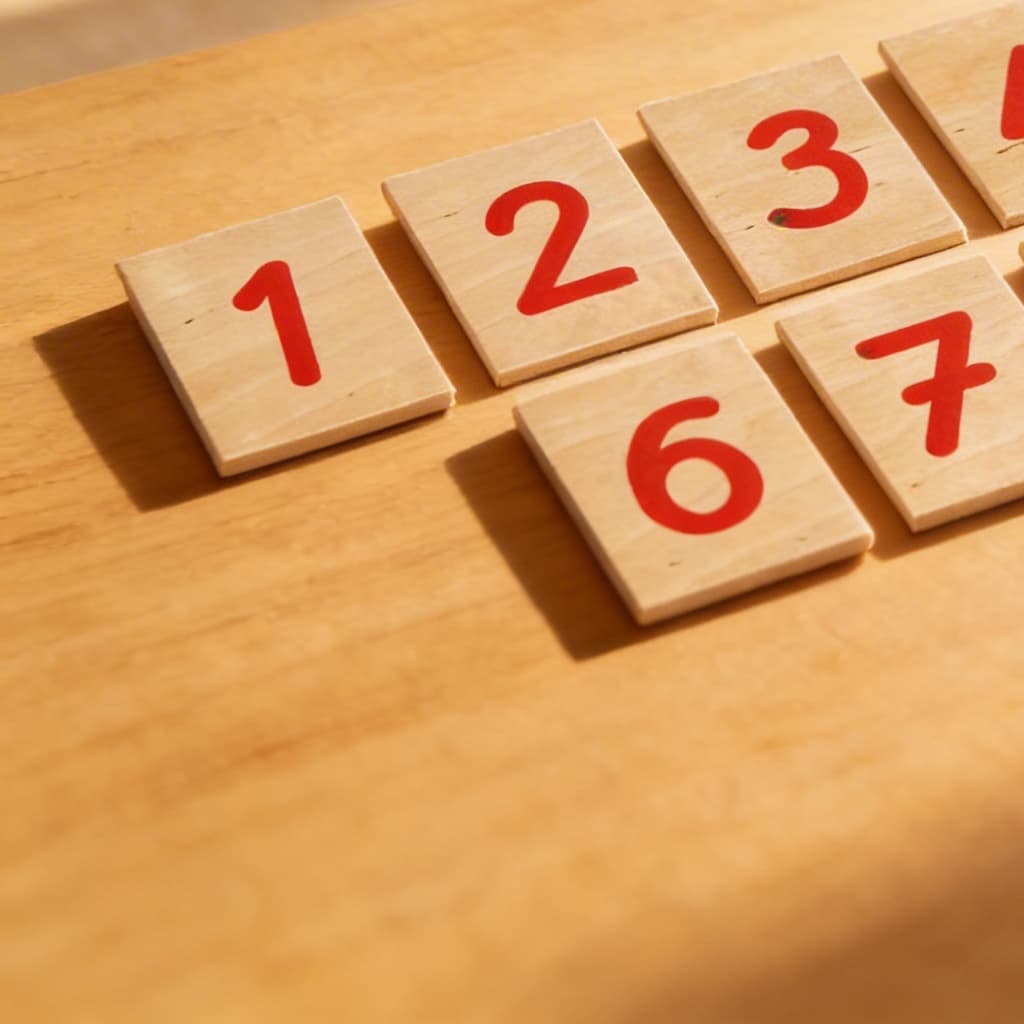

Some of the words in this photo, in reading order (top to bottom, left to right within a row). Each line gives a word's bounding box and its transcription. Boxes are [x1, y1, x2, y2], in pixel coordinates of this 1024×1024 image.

[746, 109, 869, 230] 3
[484, 180, 638, 316] 2
[231, 260, 322, 387] 1
[855, 311, 997, 458] 7
[625, 396, 764, 536] 6
